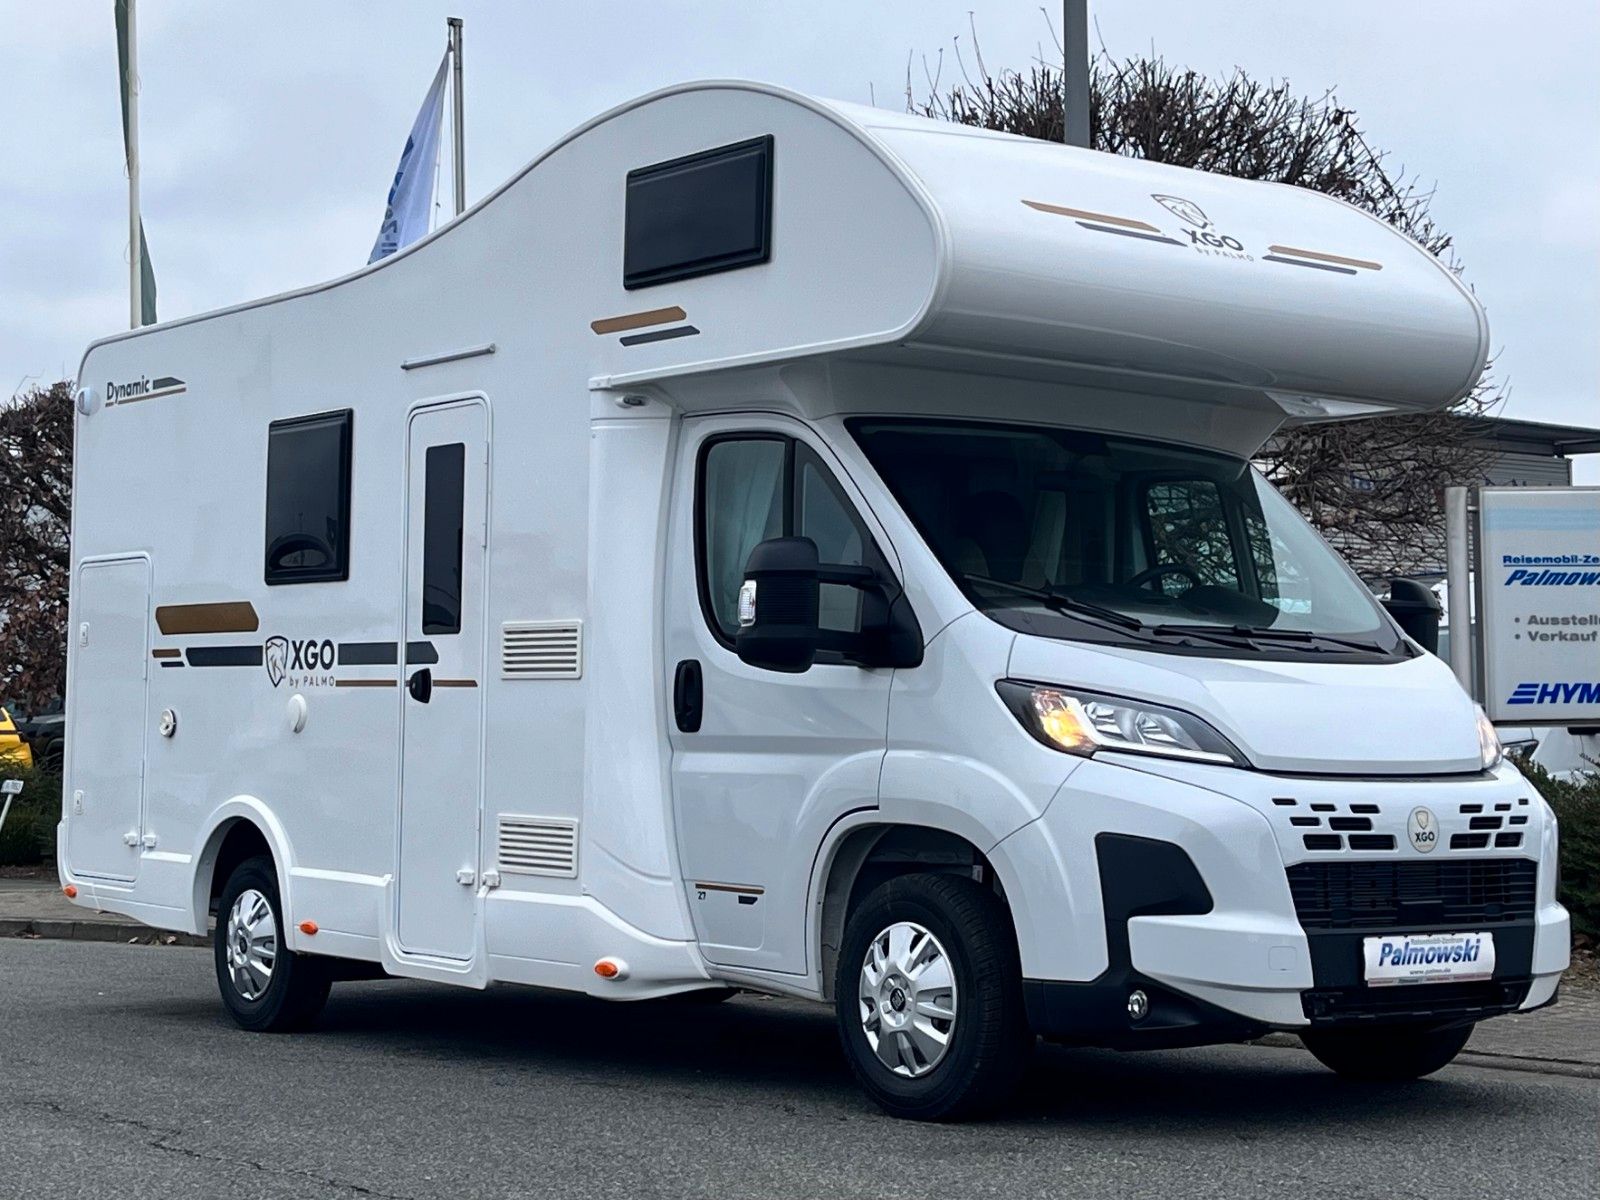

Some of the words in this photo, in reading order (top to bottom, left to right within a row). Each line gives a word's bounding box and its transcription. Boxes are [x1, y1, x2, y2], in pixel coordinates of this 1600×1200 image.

[1180, 228, 1244, 251] XGO
[106, 375, 150, 402] Dynamic
[1504, 570, 1600, 586] Palmow
[1527, 614, 1600, 625] Ausstell
[1527, 630, 1598, 642] Verkauf
[291, 639, 335, 670] XGO
[289, 676, 299, 688] by
[303, 675, 335, 687] PALMO
[1415, 831, 1435, 842] XGO
[1379, 939, 1481, 967] Palmowski
